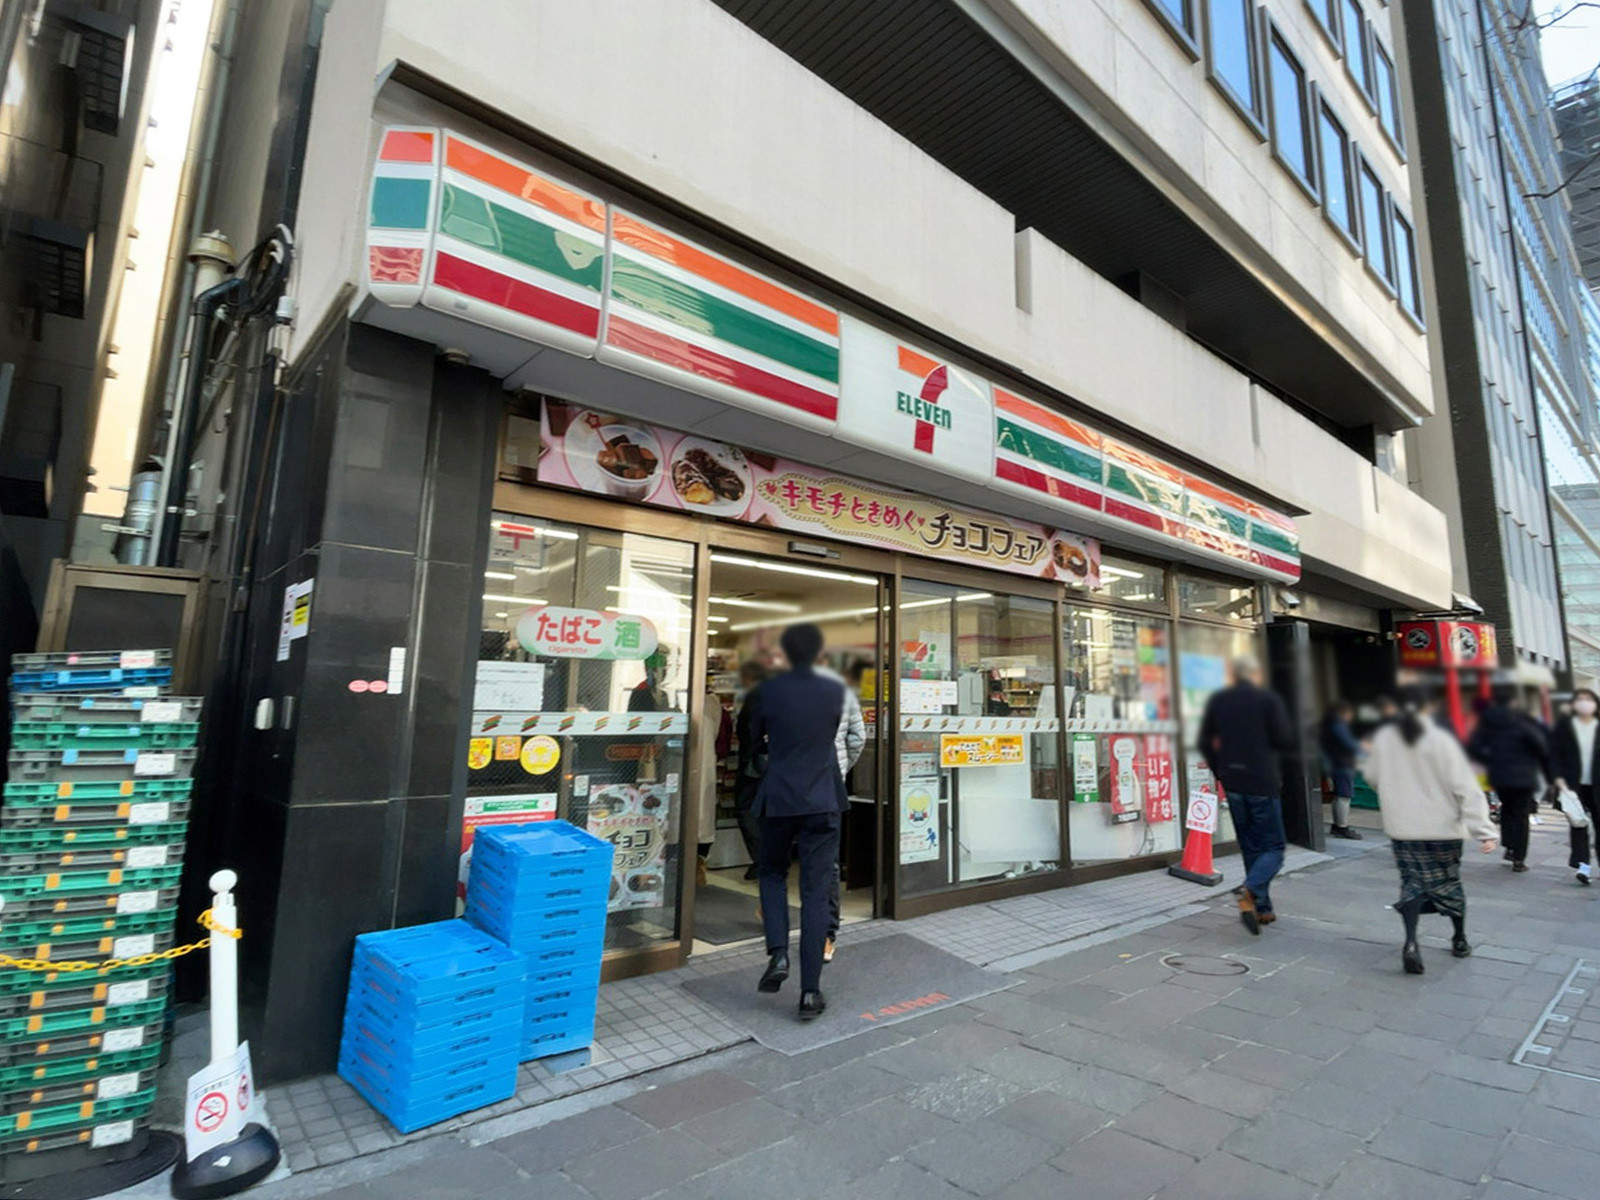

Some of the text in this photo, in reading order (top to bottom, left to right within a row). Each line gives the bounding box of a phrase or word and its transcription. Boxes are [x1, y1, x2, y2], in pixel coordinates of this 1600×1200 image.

[781, 480, 1046, 561] キモチときめく チョコフェア
[535, 613, 641, 648] たばこ 酒
[604, 829, 651, 849] チョコ
